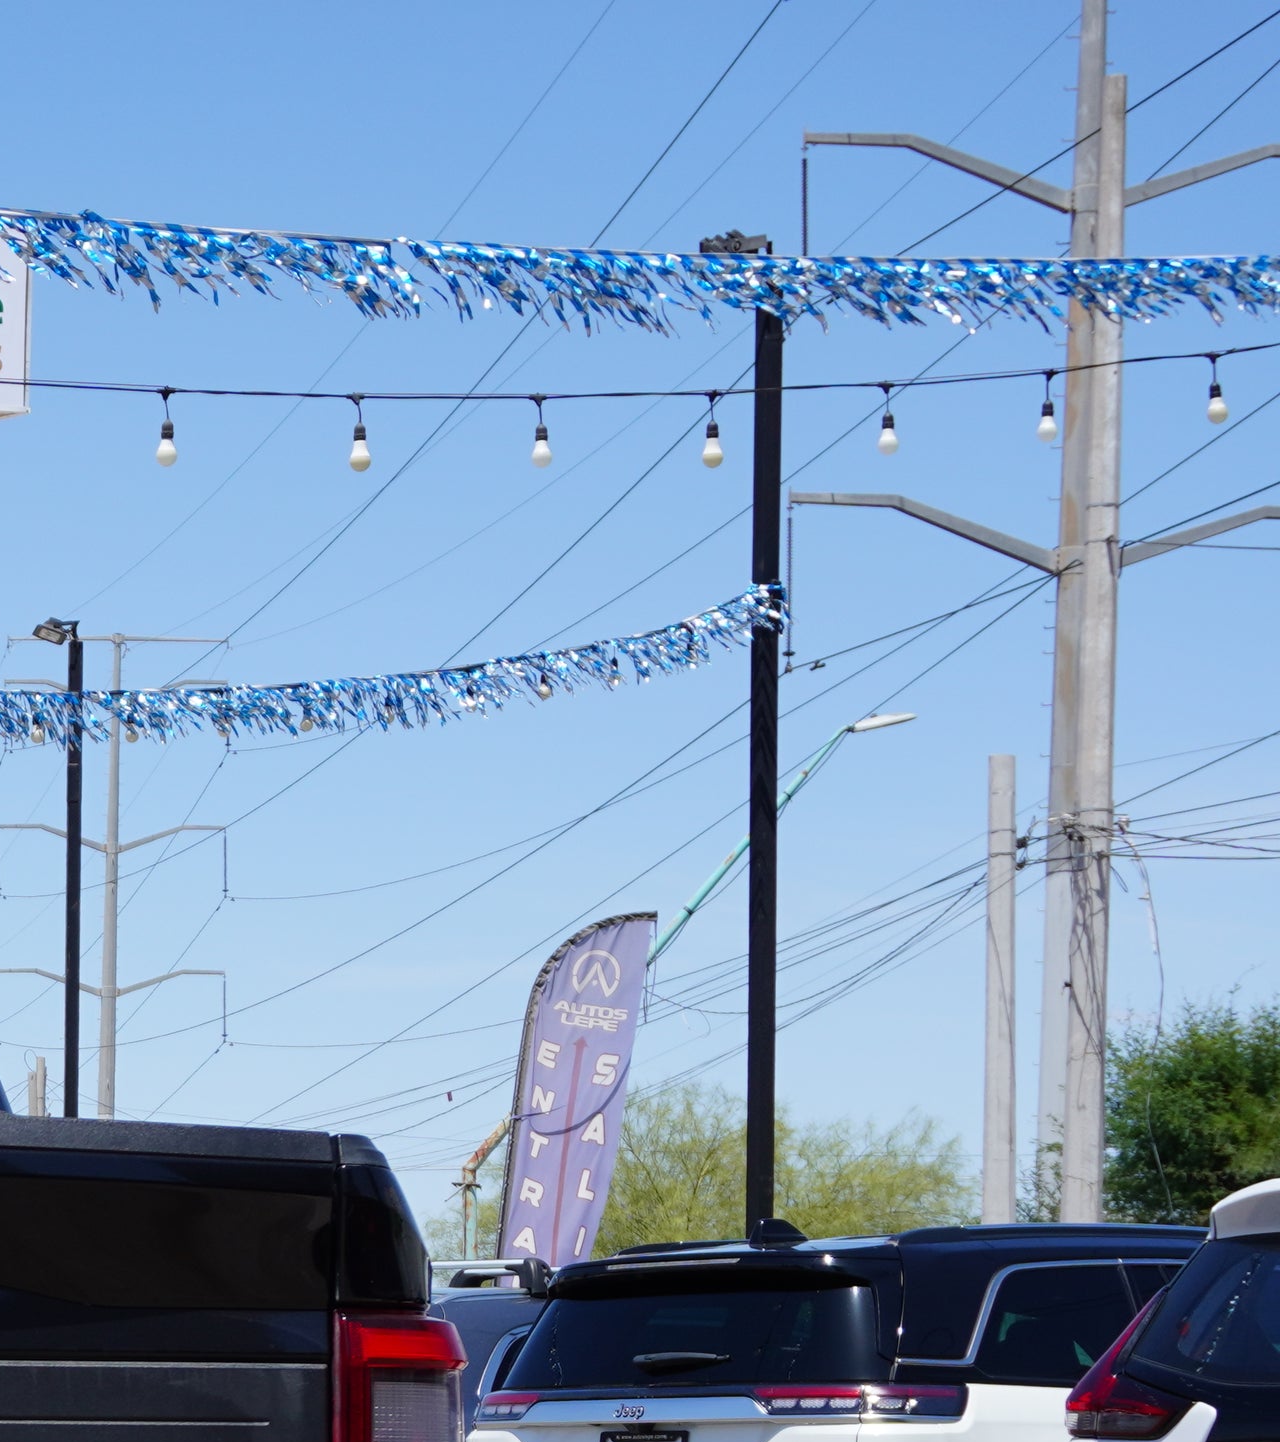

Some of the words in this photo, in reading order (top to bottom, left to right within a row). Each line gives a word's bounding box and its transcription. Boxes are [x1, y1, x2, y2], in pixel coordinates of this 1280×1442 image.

[553, 1000, 629, 1021] AUTOS
[560, 1012, 620, 1032] LEPE
[612, 1403, 644, 1420] Jeep
